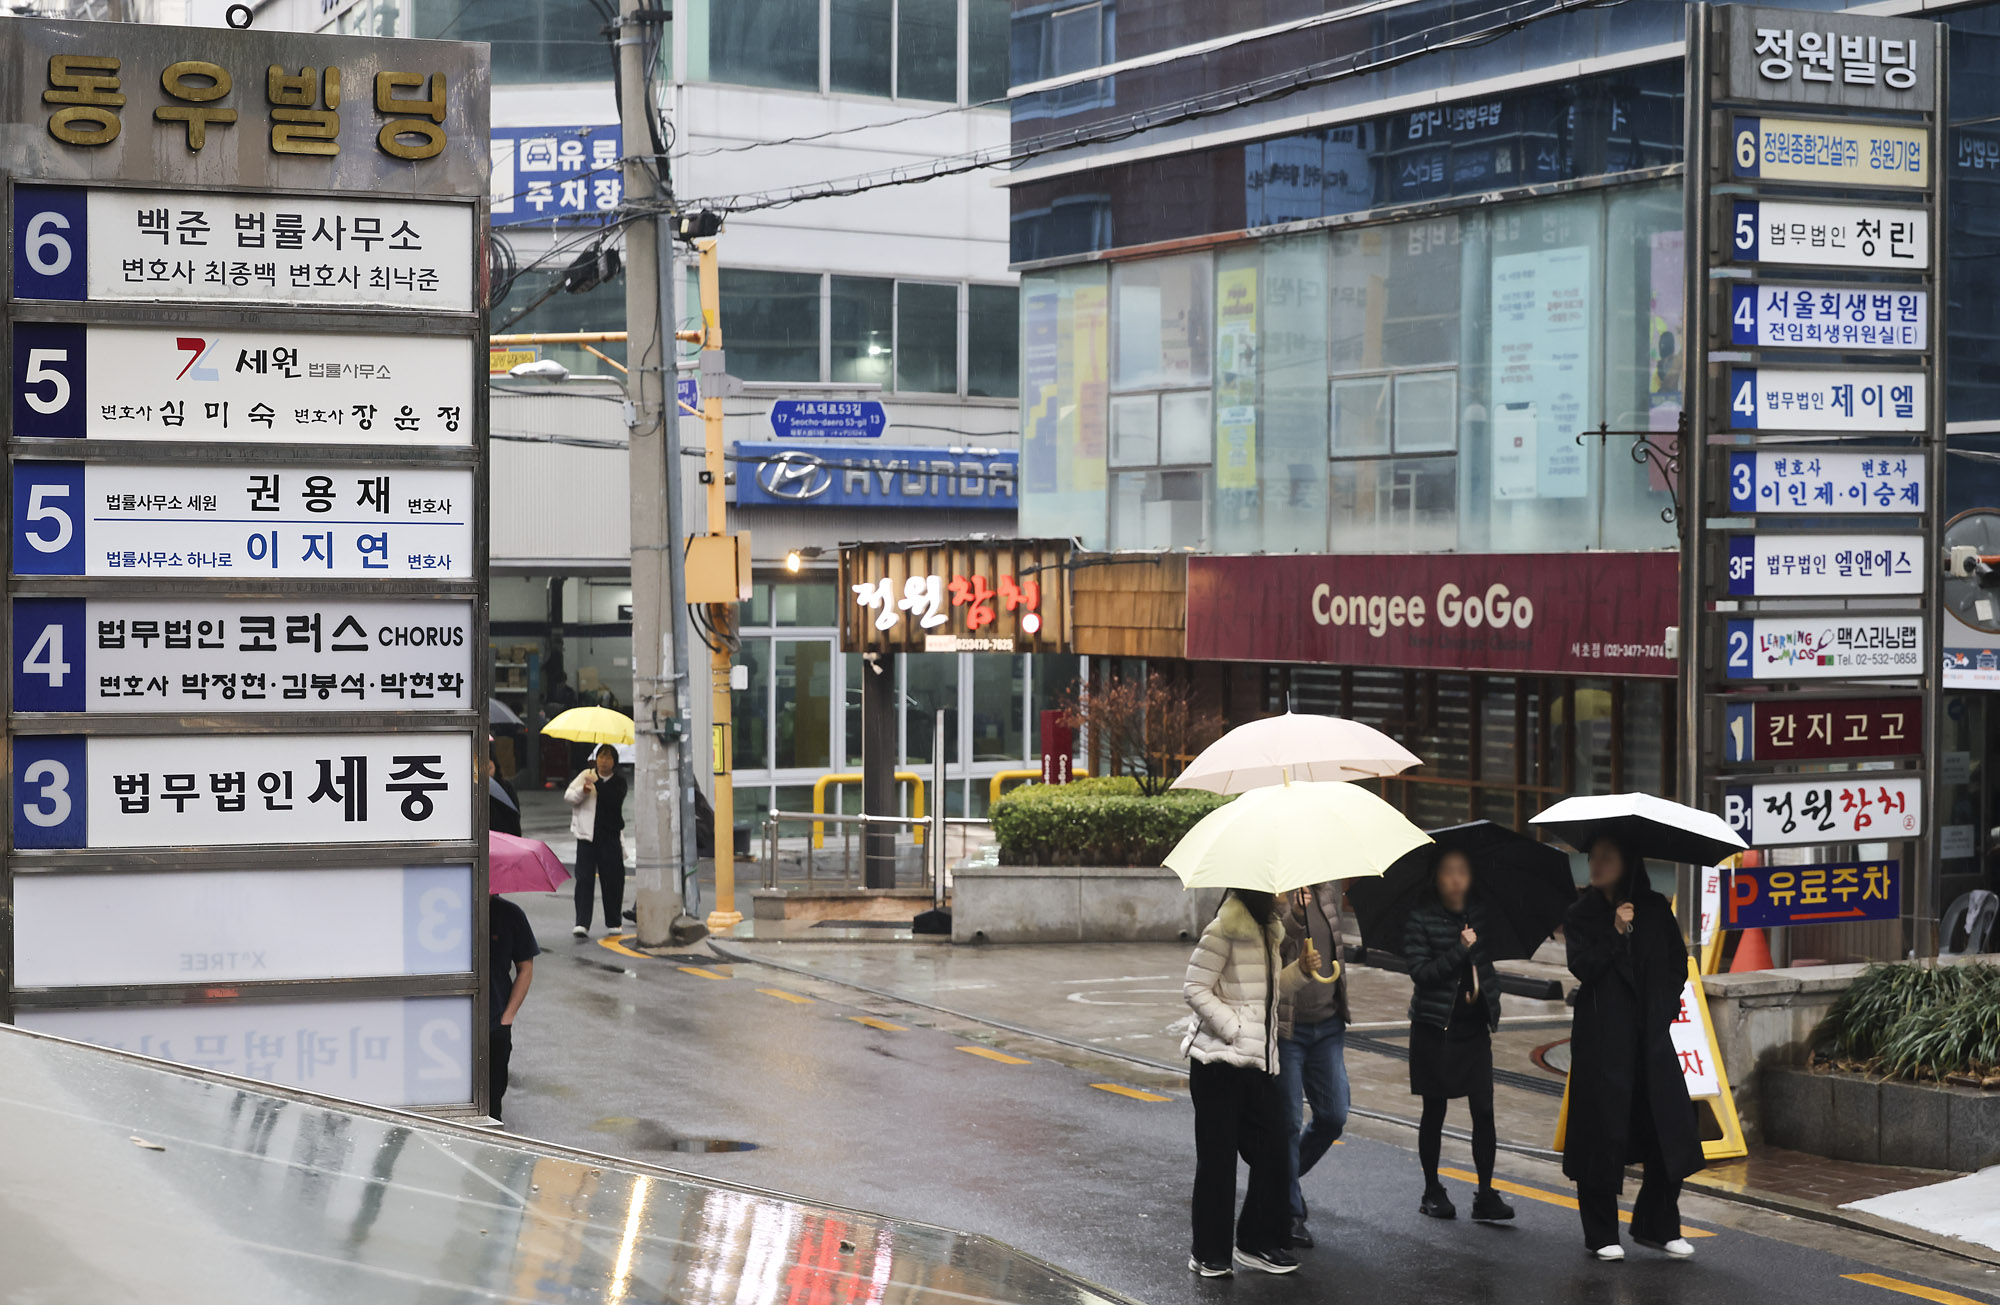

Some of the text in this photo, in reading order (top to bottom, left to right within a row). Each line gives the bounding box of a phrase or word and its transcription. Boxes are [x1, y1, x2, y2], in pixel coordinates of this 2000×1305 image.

[1754, 28, 1917, 89] 정원빌딩
[42, 54, 447, 160] 동우빌딩
[558, 140, 619, 171] 유료
[1736, 131, 1756, 168] 6
[1764, 132, 1920, 172] 정원종합건설(주) 정원기업
[525, 179, 622, 211] 주차장
[24, 211, 72, 277] 6
[137, 208, 423, 252] 백준 법률사무소
[1735, 213, 1755, 250] 5
[1770, 218, 1914, 259] 법무법인 청린
[122, 257, 440, 292] 변호사 최종백 변호사 최낙준
[1734, 297, 1754, 333] 4
[1767, 291, 1918, 322] 서울회생법원
[1768, 322, 1918, 345] 전임회생위원실(E)
[24, 348, 71, 414] 5
[235, 347, 391, 382] 세원 법률사무소
[101, 404, 152, 423] 변호사
[294, 408, 344, 425] 변호사
[795, 403, 861, 416] 서초대로53길
[1733, 381, 1754, 416] 4
[1766, 384, 1913, 418] 법무법인 제이엘
[790, 417, 844, 427] Seocho-daero
[844, 458, 1019, 497] HYUNDA
[1732, 463, 1751, 501] 3
[1774, 458, 1907, 479] 변호사 변호사
[25, 484, 73, 553] 5
[106, 493, 182, 512] 법률사무소
[187, 494, 217, 512] 세원
[408, 498, 452, 515] 변호사
[106, 550, 182, 569] 법률사무소
[187, 551, 232, 569] 하나로
[408, 554, 452, 571] 변호사
[1729, 556, 1753, 580] 3F
[1767, 550, 1912, 577] 법무법인 엘앤에스
[1311, 583, 1533, 638] Congee GoGo
[98, 613, 464, 653] 법무법인 코러스 CHORUS
[1729, 631, 1748, 667] 2
[1838, 626, 1916, 649] 맥스러닝랩
[22, 624, 71, 687] 4
[1838, 654, 1852, 665] Tel.
[1856, 653, 1917, 665] 02-532-0858
[100, 675, 169, 697] 변호사
[1730, 715, 1744, 761] 1
[1769, 713, 1904, 746] 칸지고고
[23, 759, 72, 828] 3
[113, 755, 448, 822] 법무법인 세중
[1763, 786, 1905, 833] 정원참치
[1728, 874, 1759, 924] P
[1768, 865, 1891, 906] 유료주차
